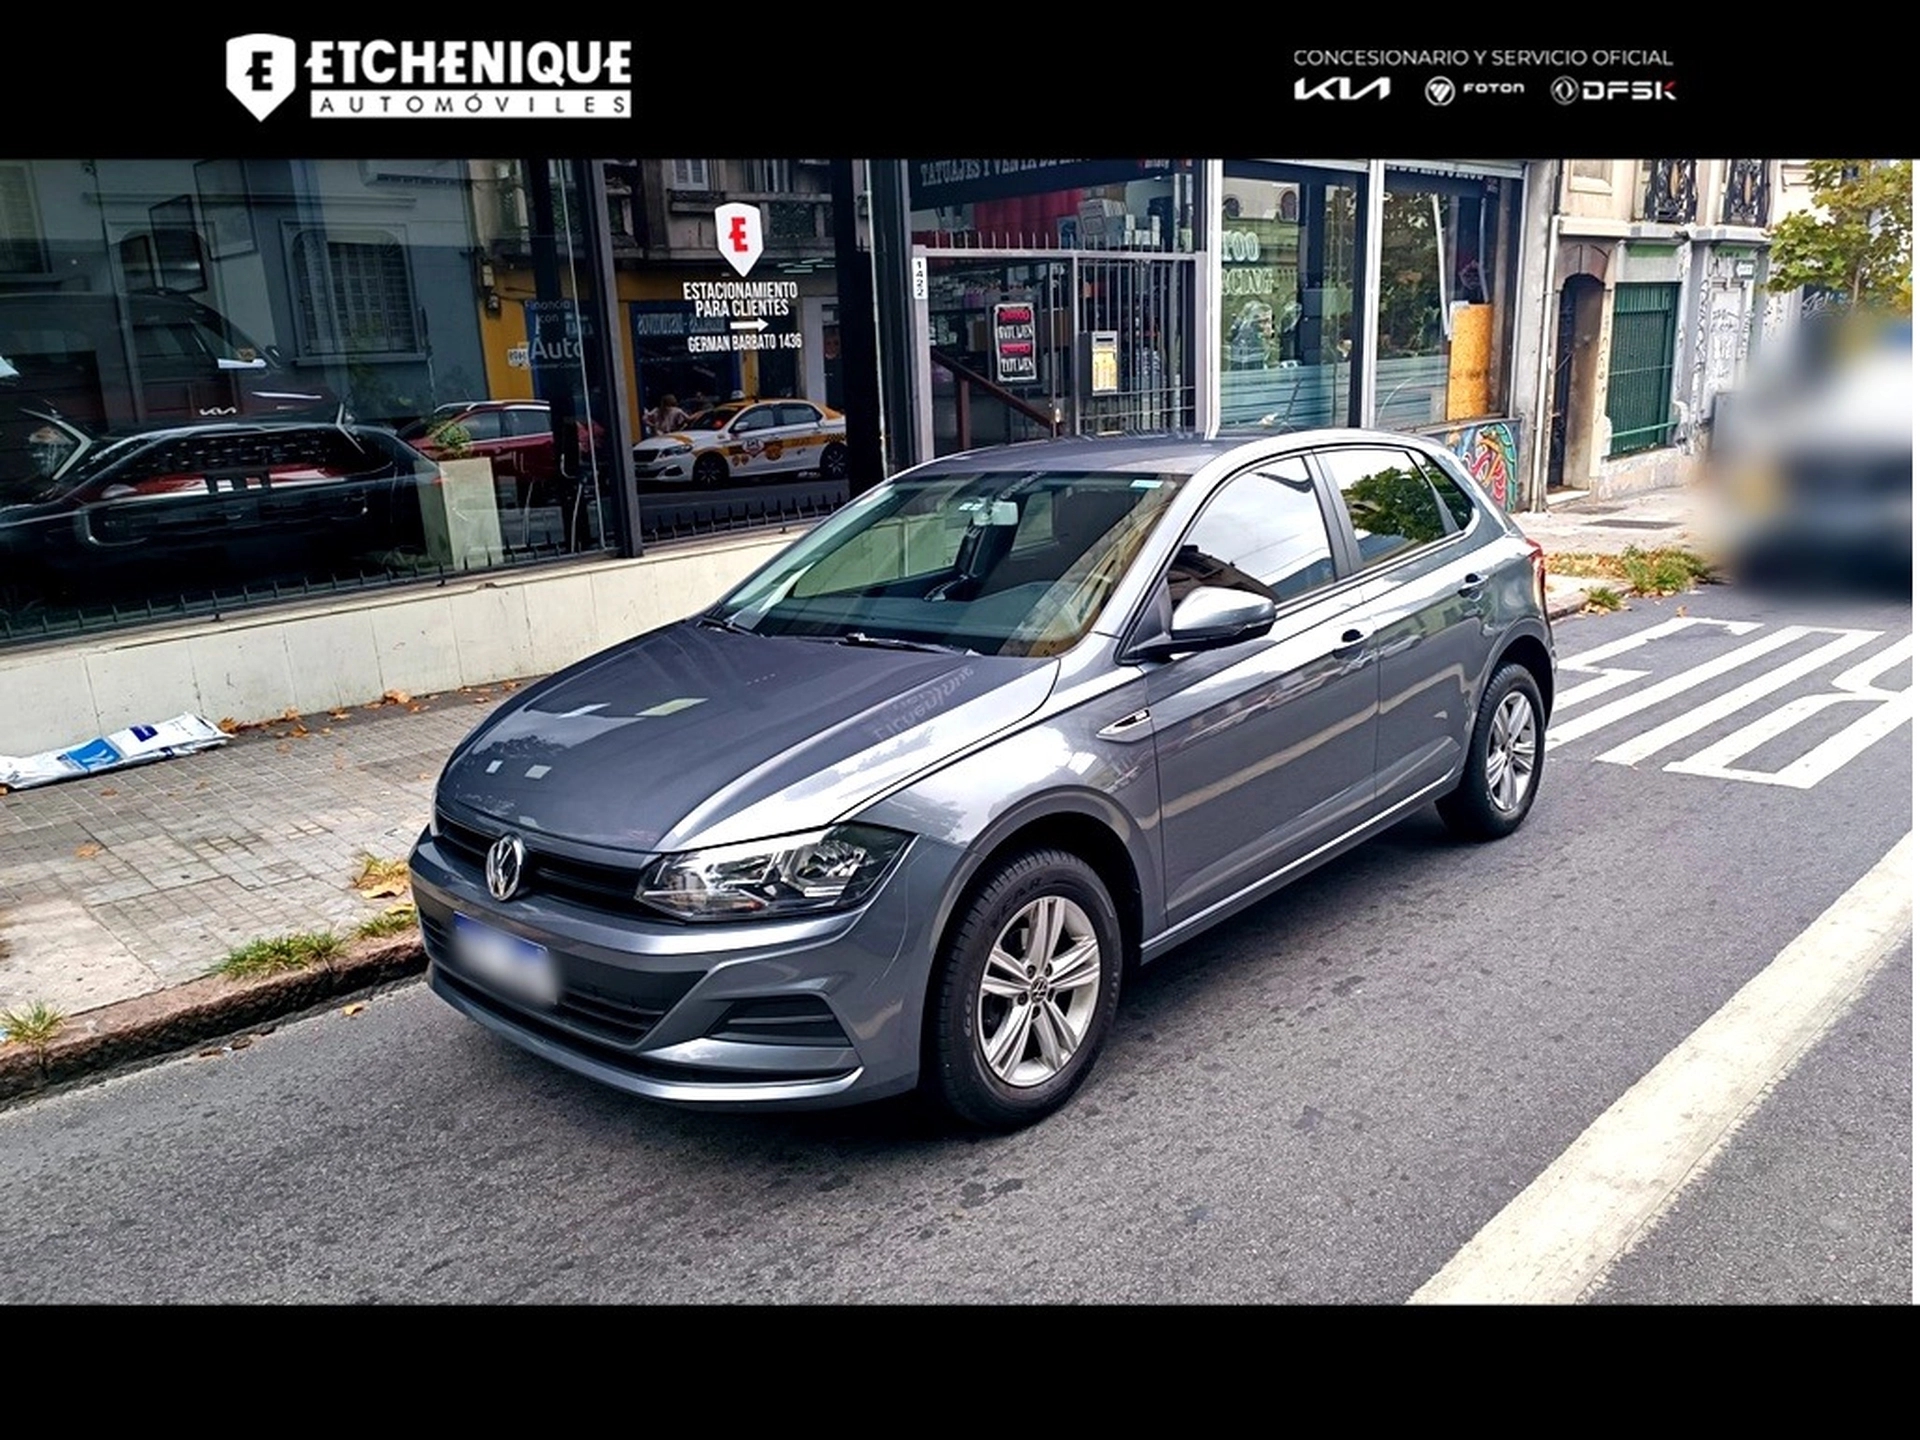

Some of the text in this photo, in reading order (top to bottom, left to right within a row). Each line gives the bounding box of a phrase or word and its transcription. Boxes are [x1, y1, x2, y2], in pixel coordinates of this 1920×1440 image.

[915, 261, 924, 297] 1422
[682, 281, 798, 300] ESTACIONAMIENTO
[695, 298, 790, 318] PARA CLIENTES
[687, 331, 803, 353] GERMAN BARBATO 1436
